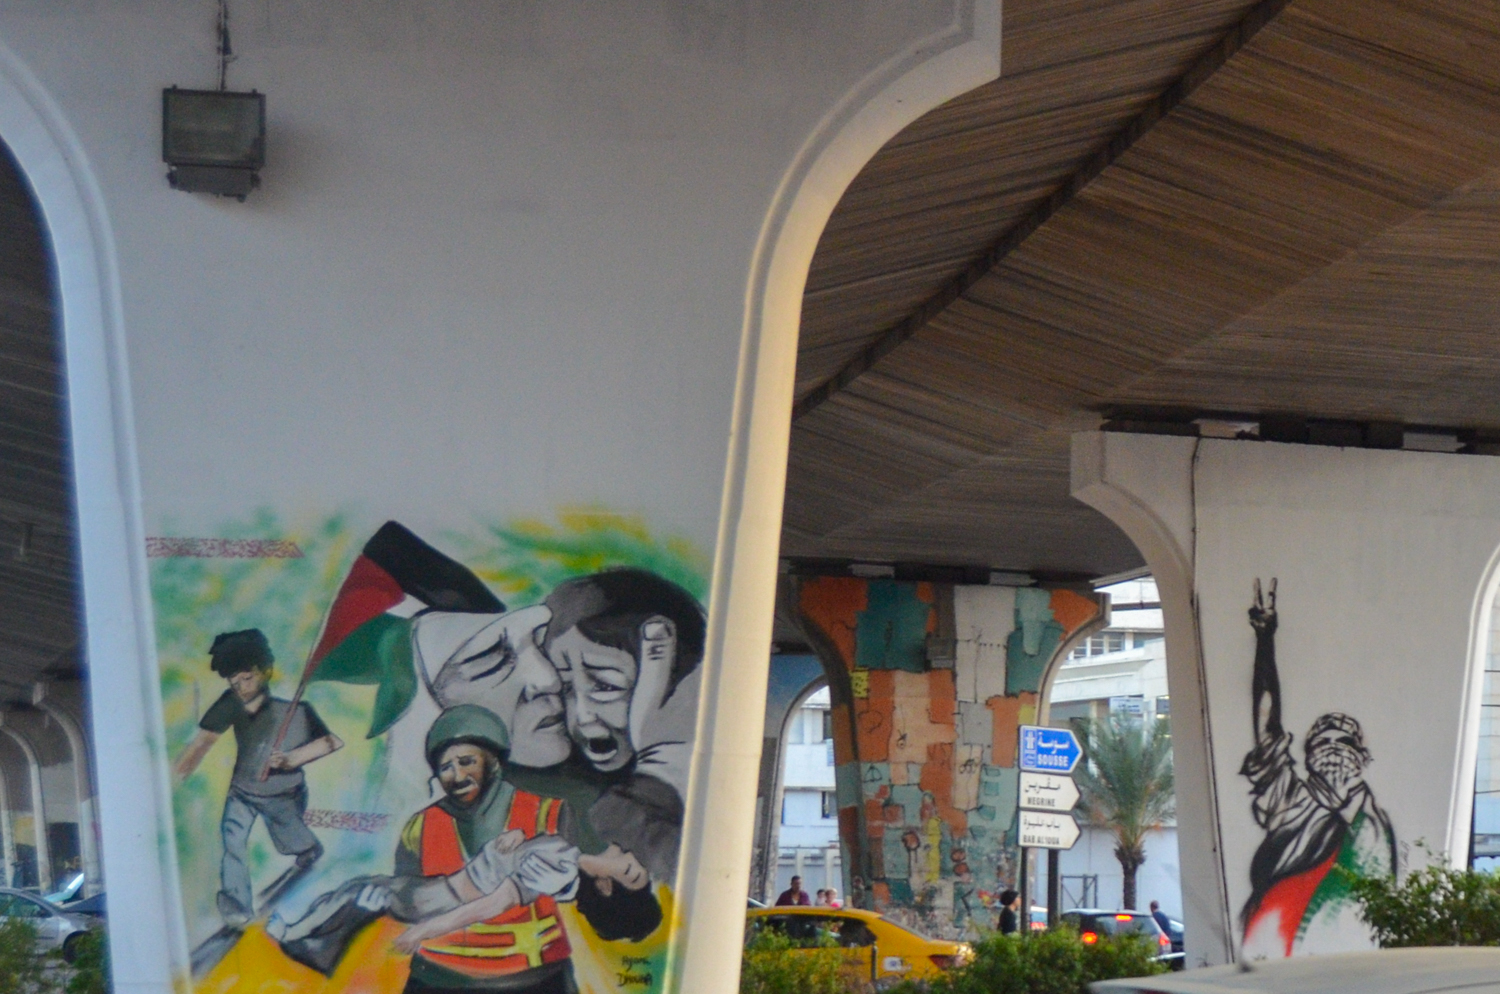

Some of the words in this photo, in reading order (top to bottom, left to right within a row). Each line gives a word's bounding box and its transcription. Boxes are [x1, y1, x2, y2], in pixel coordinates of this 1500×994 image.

[1038, 732, 1069, 754] سوسة
[1037, 754, 1069, 767] SOUSSE
[1023, 834, 1036, 844] BAB
